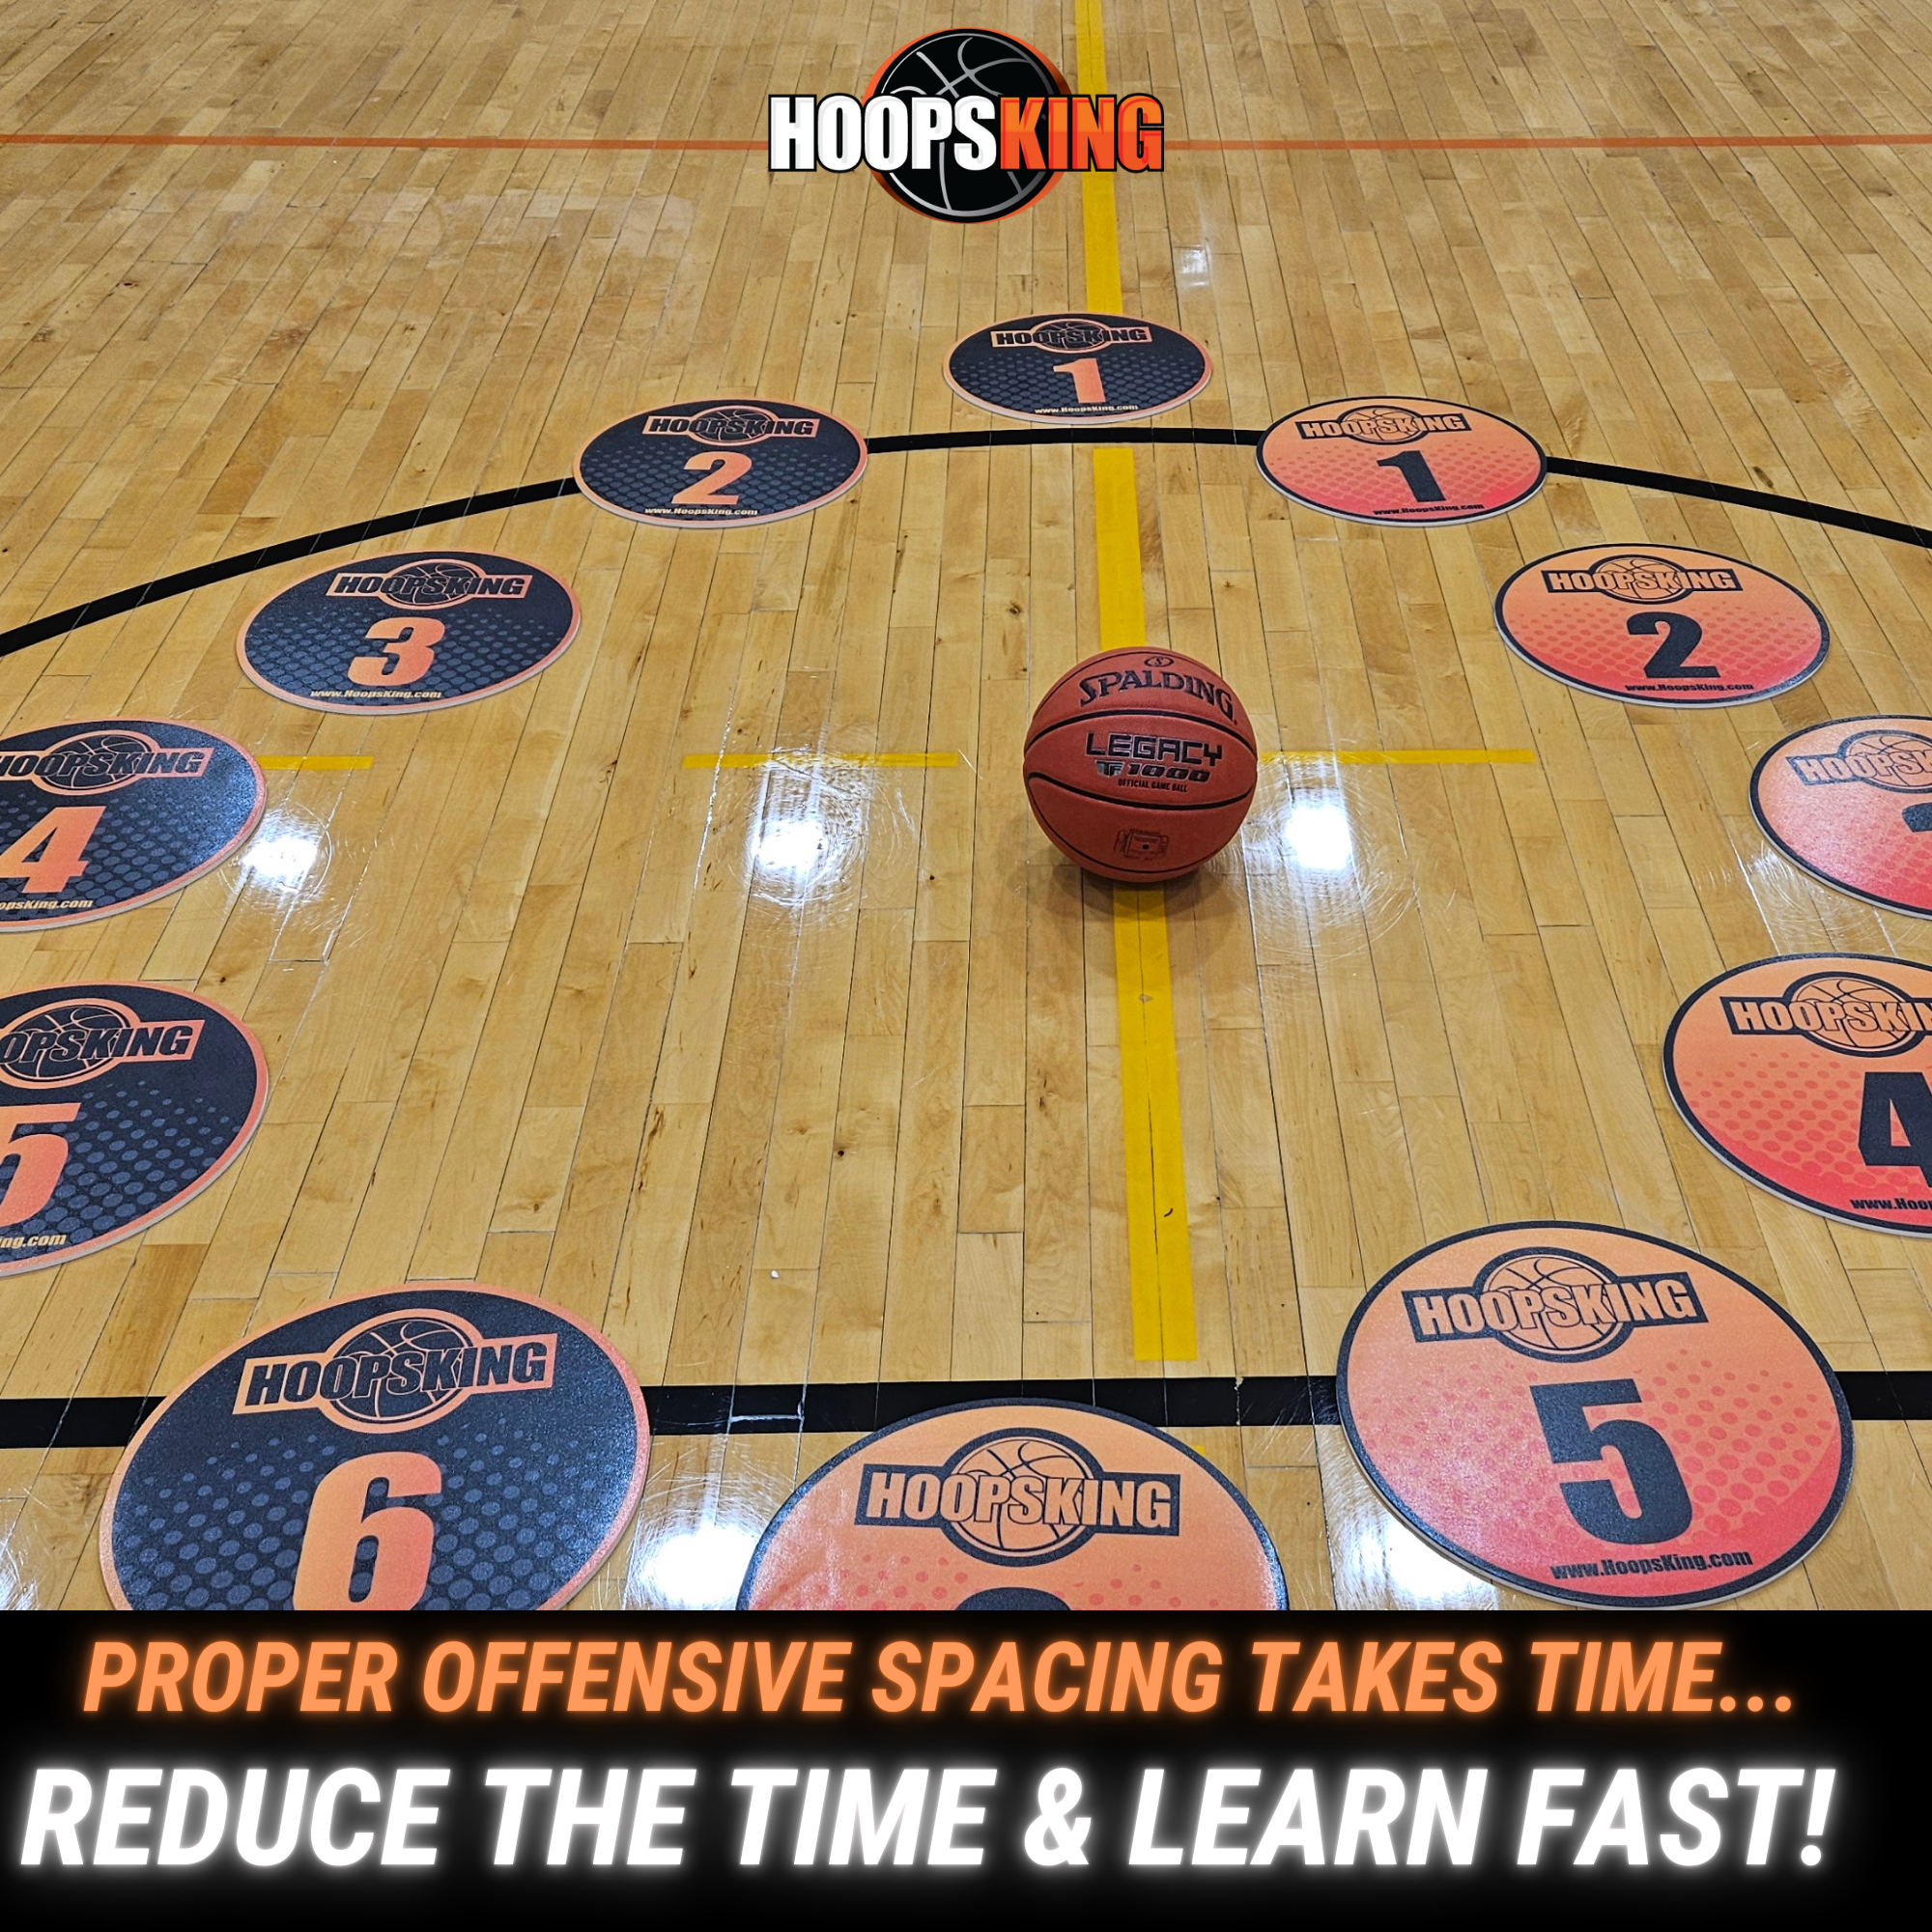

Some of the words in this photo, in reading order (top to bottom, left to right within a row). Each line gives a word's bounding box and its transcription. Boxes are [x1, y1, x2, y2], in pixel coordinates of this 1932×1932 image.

[995, 327, 1149, 345] HOOPSKING
[1053, 357, 1106, 404] 1
[648, 415, 815, 436] HOOPSKING
[1034, 404, 1139, 414] www.HoopsKing.com
[1300, 415, 1466, 438] HOOPSKING
[671, 450, 753, 505] 2
[1377, 449, 1447, 503] 1
[644, 506, 758, 517] www.HoopsKing.com
[1373, 503, 1486, 516] www.HoopsKing.com
[335, 574, 526, 596] HOOPSKING
[1547, 570, 1737, 592] HOOPSKING
[348, 616, 445, 687] 3
[1626, 611, 1721, 678] 2
[310, 688, 442, 699] www.HoopsKing.com
[1079, 669, 1234, 722] SPALDING
[1624, 682, 1754, 692] www.HoopsKing.com
[1086, 732, 1223, 767] LEGACY
[1118, 778, 1150, 789] OFFICIAL
[1151, 780, 1170, 791] GAME
[1172, 782, 1188, 793] BALL
[1127, 762, 1211, 782] 1000
[0, 806, 107, 894] 4
[1858, 1071, 1932, 1189] 4
[1411, 1279, 1701, 1336] HOOPSKING
[244, 1341, 549, 1406] HOOPSKING
[1529, 1378, 1693, 1546] 5
[865, 1470, 1173, 1528] HOOPSKING
[292, 1451, 442, 1610] 6
[1549, 1550, 1753, 1580] www.HoopsKing.com
